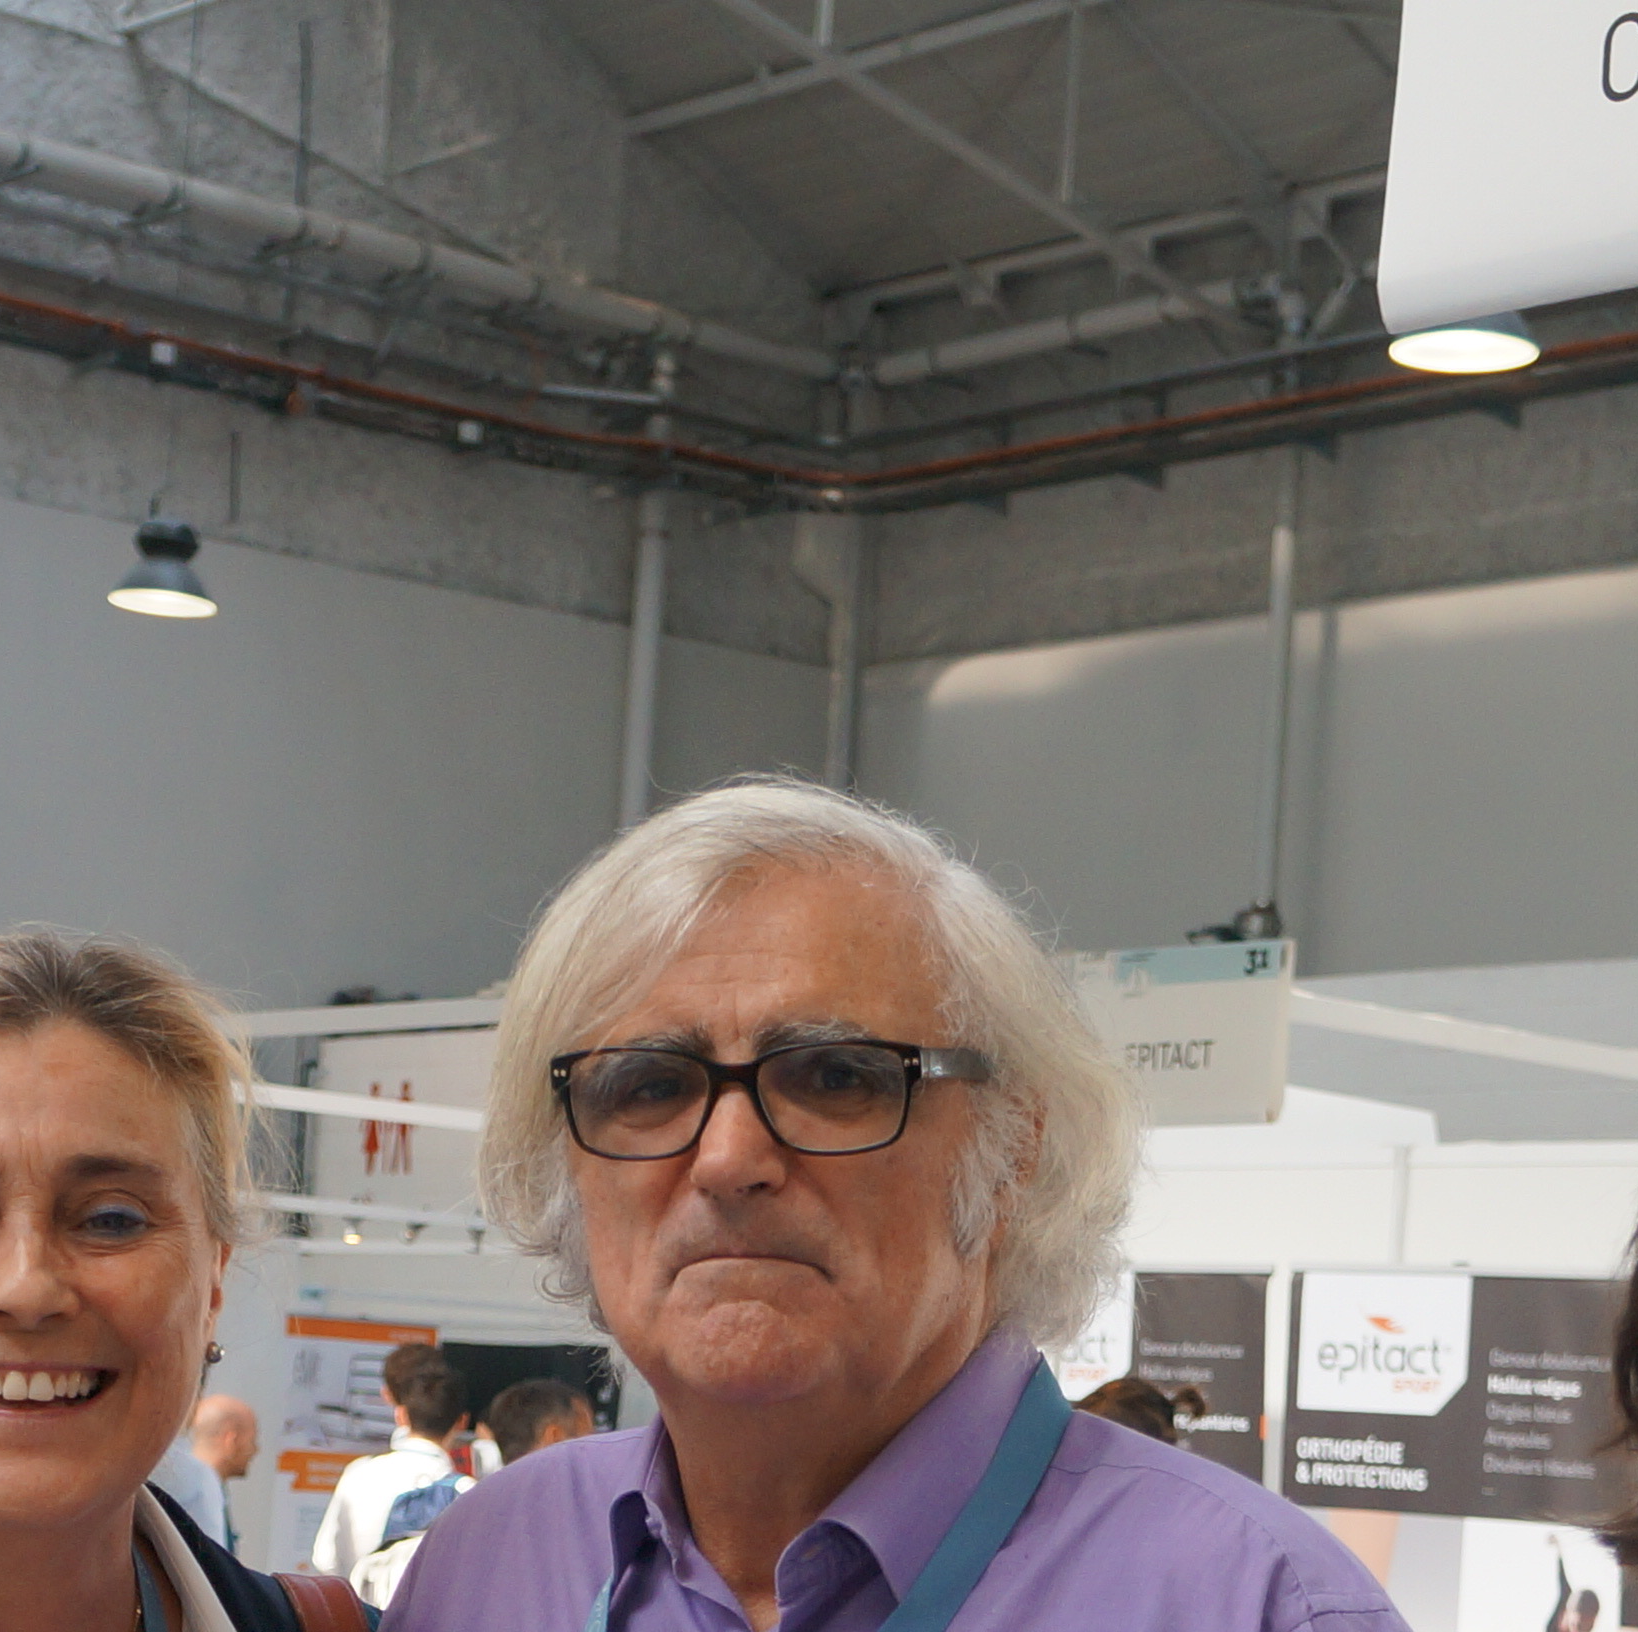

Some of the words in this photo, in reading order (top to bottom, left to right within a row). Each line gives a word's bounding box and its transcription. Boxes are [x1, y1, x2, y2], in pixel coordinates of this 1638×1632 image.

[1125, 1040, 1215, 1072] EPITACT
[1318, 1337, 1442, 1385] epitact
[1487, 1373, 1532, 1395] Hallux
[1296, 1434, 1405, 1466] ORTHOPÉDIE
[1295, 1461, 1310, 1485] &
[1311, 1463, 1429, 1491] PROTECTIONS
